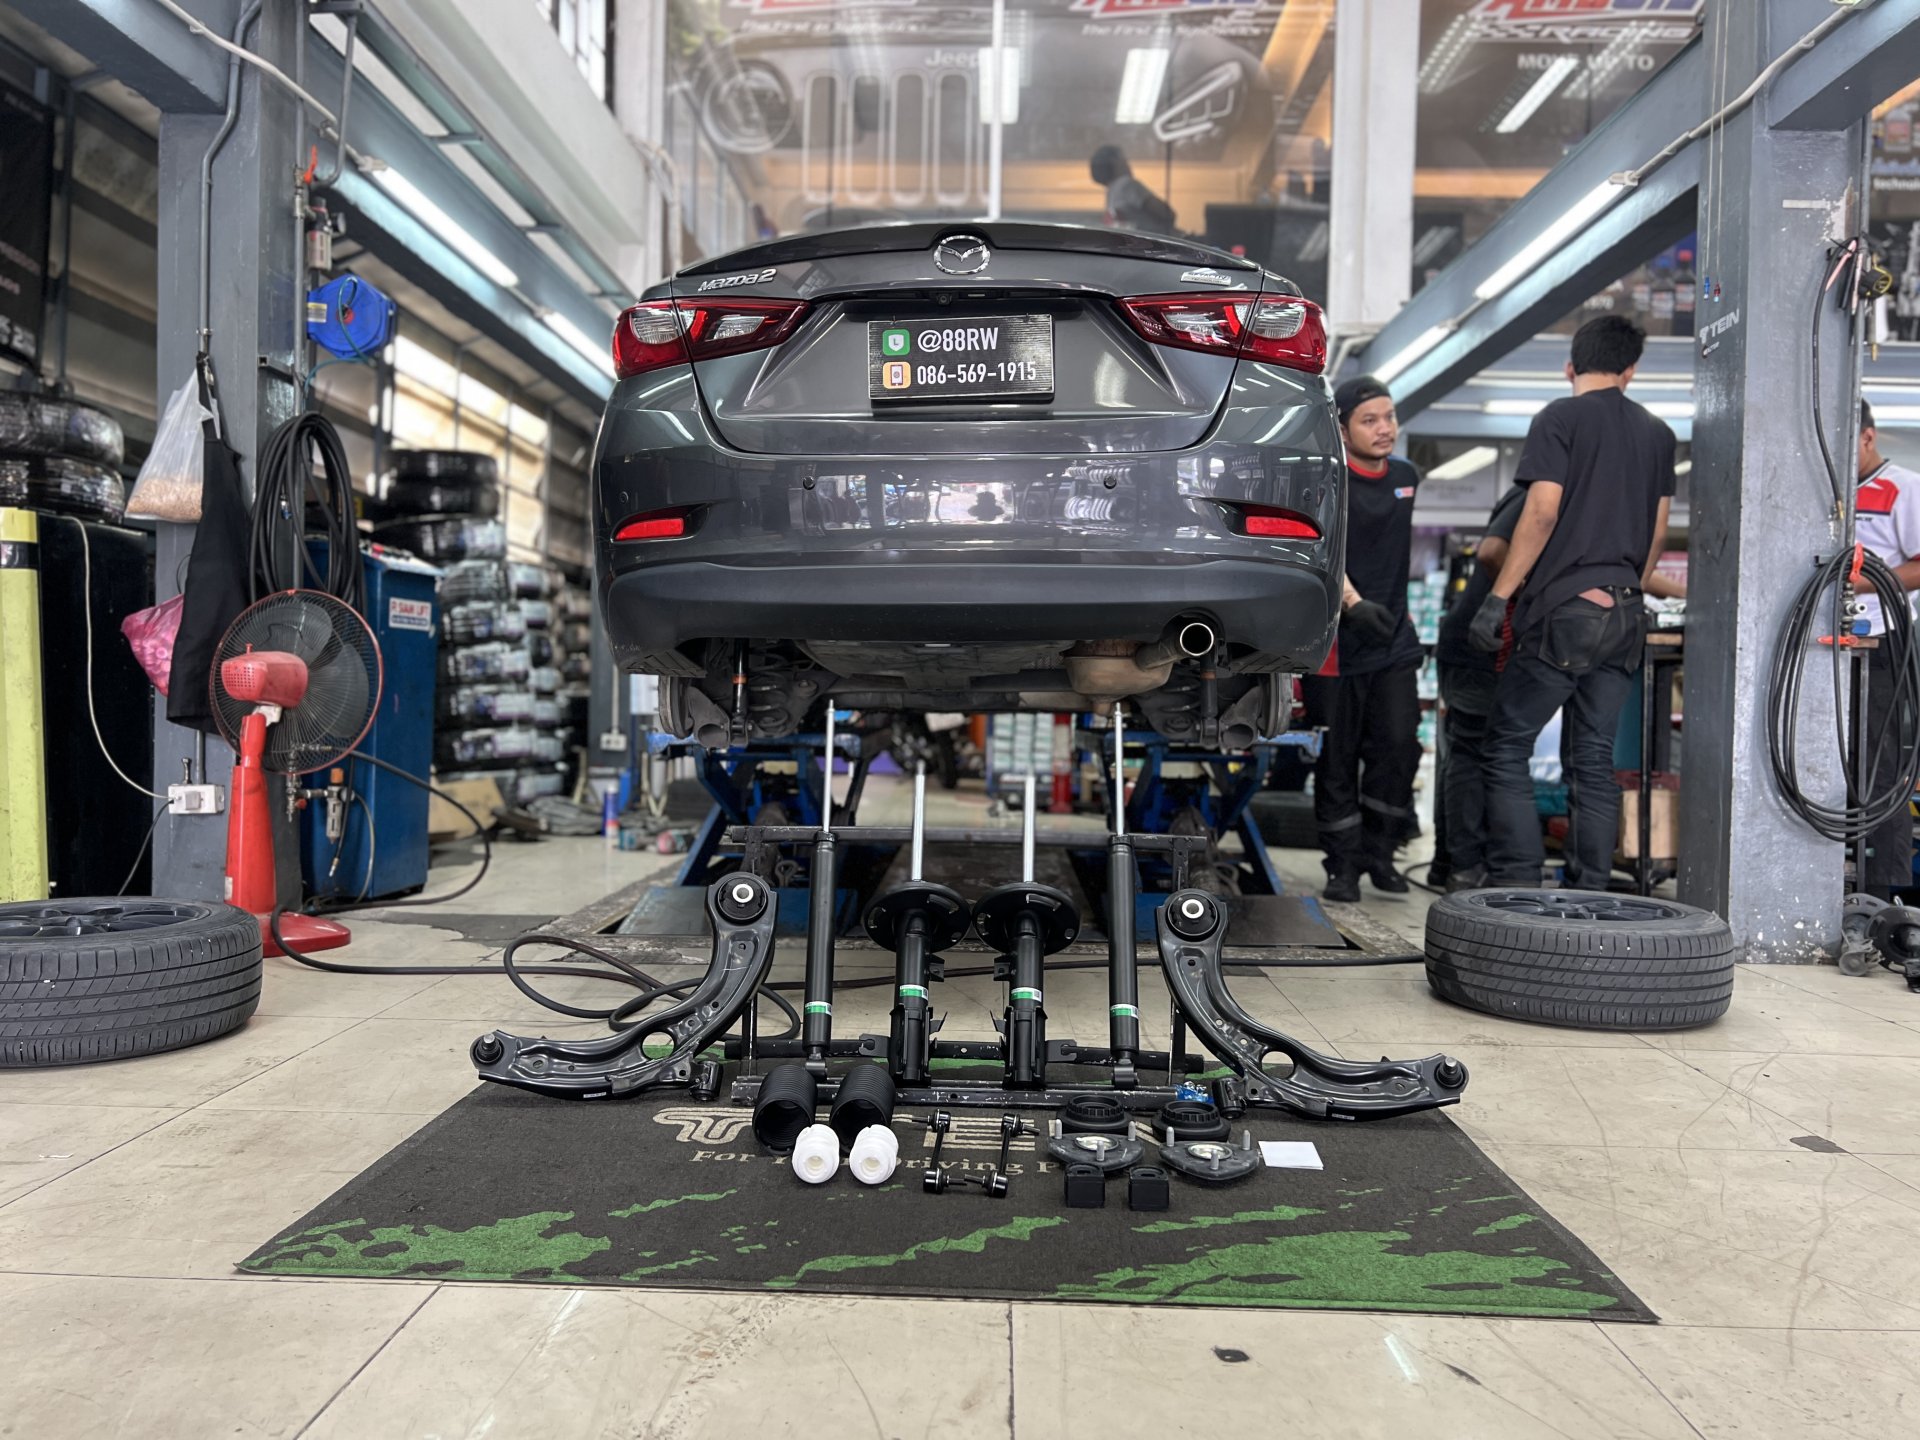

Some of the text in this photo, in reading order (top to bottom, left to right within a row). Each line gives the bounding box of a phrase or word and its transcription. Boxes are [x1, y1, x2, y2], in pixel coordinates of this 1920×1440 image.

[1710, 308, 1740, 338] TEIN
[917, 327, 999, 353] @88RW
[916, 361, 1037, 385] 086-569-1915
[689, 1150, 756, 1163] For
[896, 1154, 1024, 1176] riving
